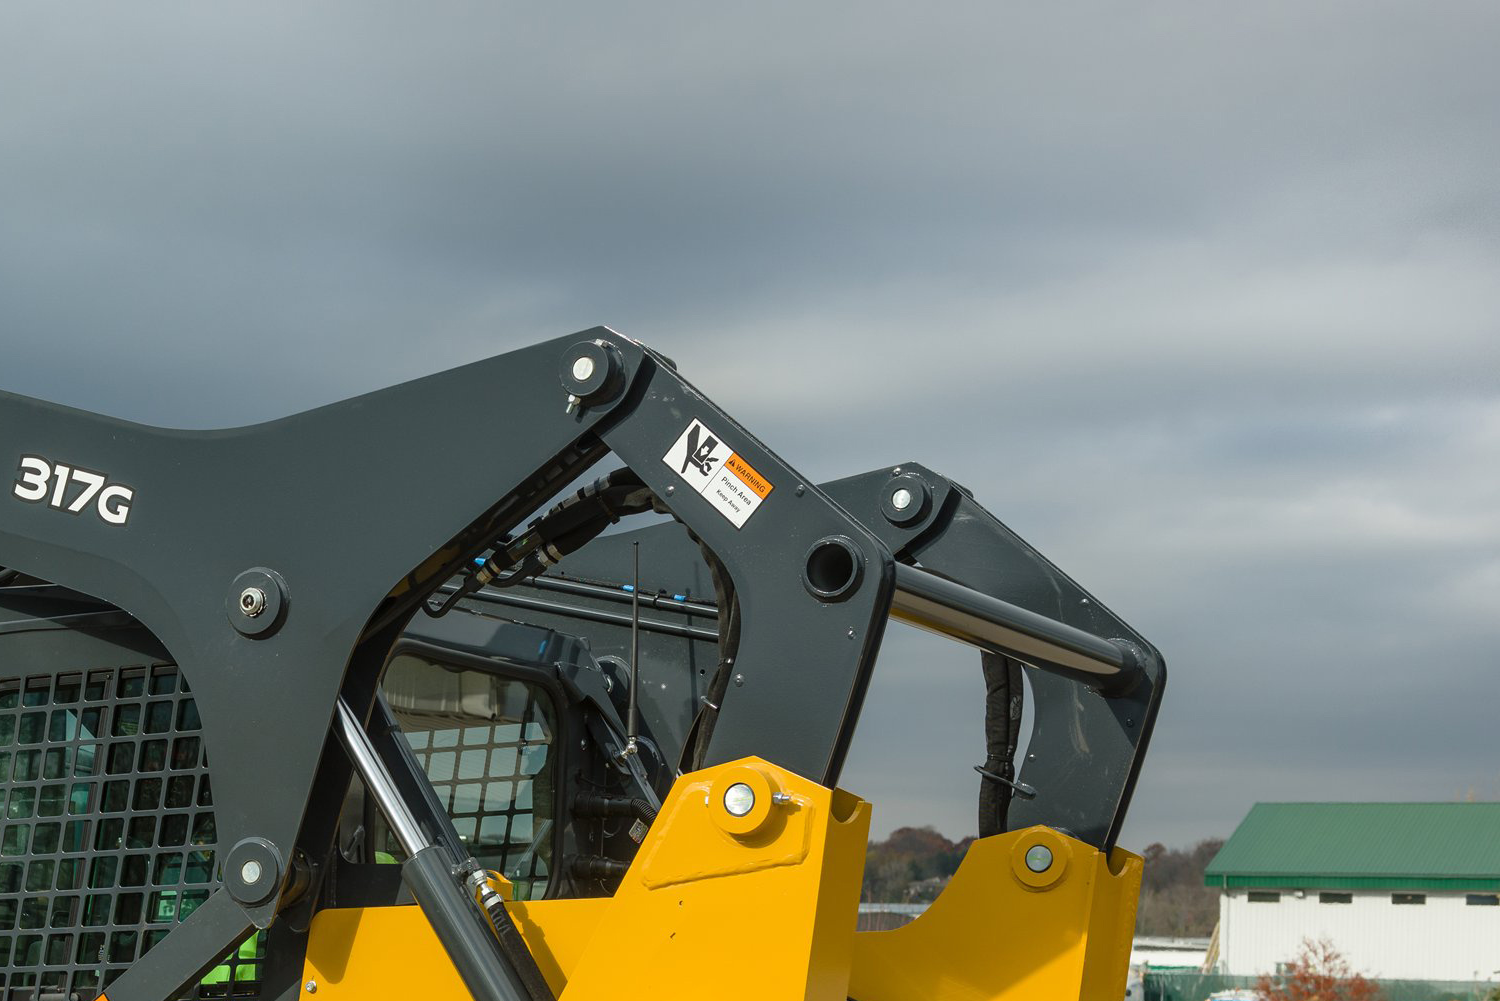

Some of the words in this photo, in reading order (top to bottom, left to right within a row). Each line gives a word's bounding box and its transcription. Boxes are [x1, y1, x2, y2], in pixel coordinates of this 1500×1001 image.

[15, 457, 134, 524] 317G
[721, 476, 737, 493] Pinch
[738, 492, 751, 506] Area
[735, 463, 766, 493] WARNING
[716, 489, 729, 502] Keep
[728, 500, 741, 513] Away
